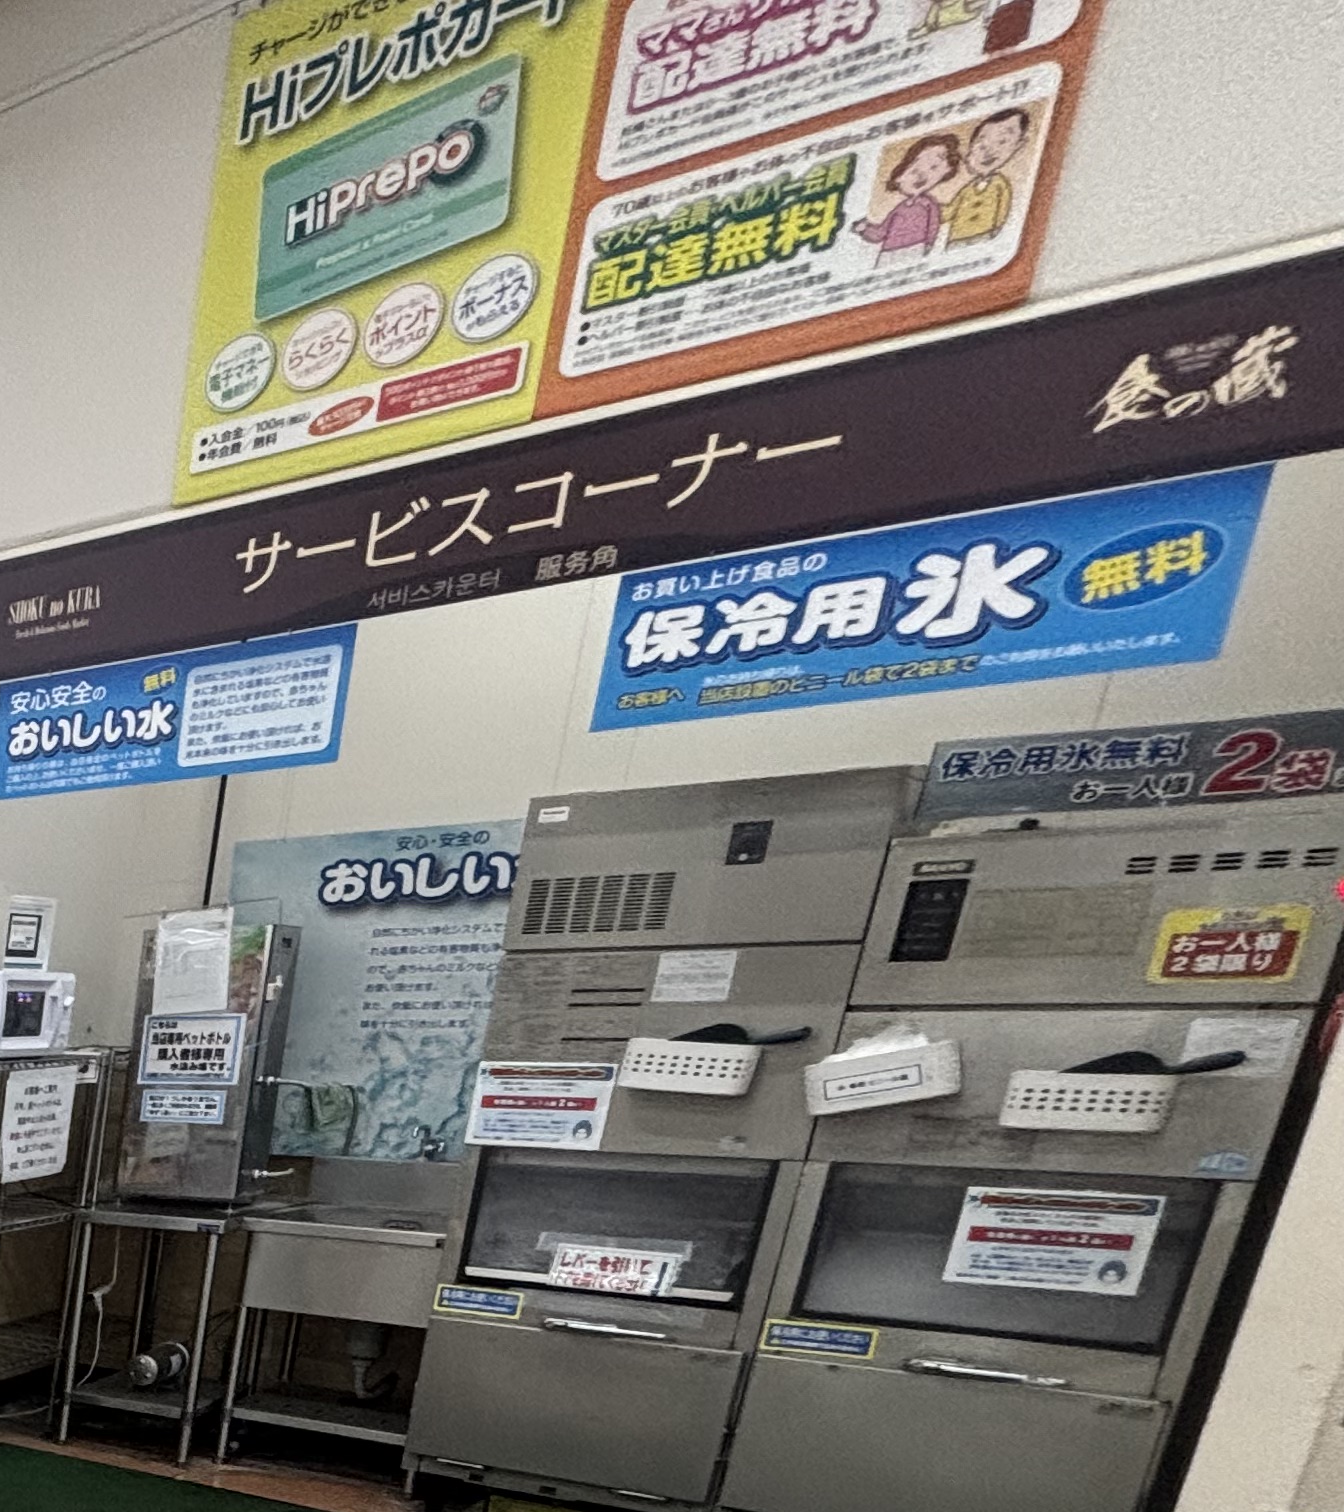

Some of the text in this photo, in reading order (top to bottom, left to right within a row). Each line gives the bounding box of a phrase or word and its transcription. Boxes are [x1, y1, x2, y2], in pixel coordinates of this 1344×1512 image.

[584, 192, 838, 308] 配達無料
[459, 275, 529, 319] ボーナス
[369, 304, 437, 346] ポイント
[288, 327, 351, 371] らくらく
[1083, 322, 1300, 434] 食の蔵
[235, 432, 845, 594] サービスコーナー
[533, 544, 619, 582] 服务角
[630, 551, 829, 604] お買い上げ食品の
[1079, 531, 1209, 604] 無料
[366, 568, 503, 610] 서비스카운터
[621, 542, 1052, 669] 保冷用氷
[10, 682, 107, 716] 安心安全の
[143, 669, 178, 693] 無料
[616, 689, 687, 710] お客様へ
[8, 700, 175, 758] おいしい水
[940, 731, 1192, 783] 保冷用氷無料
[1070, 772, 1195, 804] お一人様
[395, 829, 491, 852] 安心・安全の
[320, 850, 518, 905] おいしい
[1170, 932, 1283, 955] お一人様
